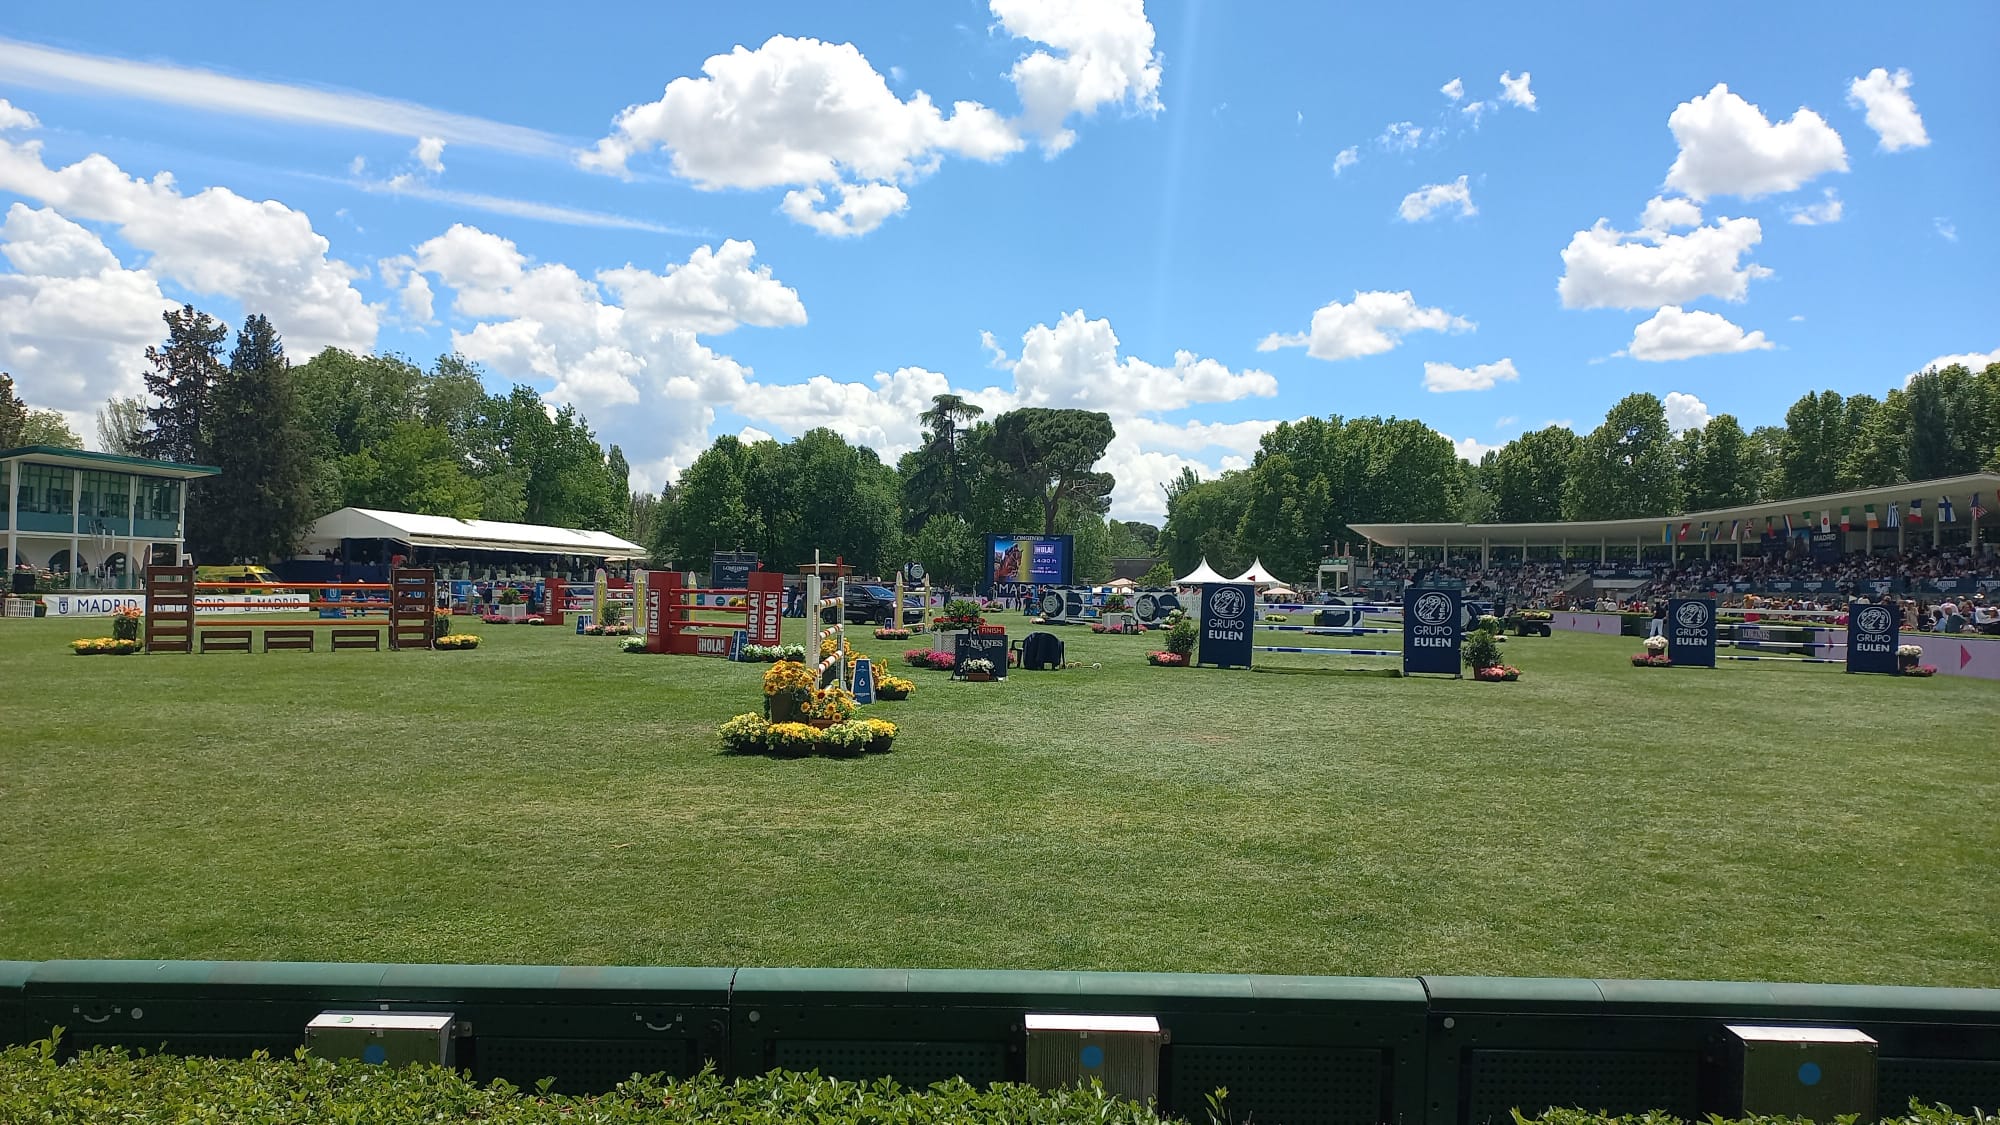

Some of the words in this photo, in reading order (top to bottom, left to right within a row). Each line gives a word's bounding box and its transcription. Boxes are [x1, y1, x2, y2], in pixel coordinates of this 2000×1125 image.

[649, 591, 659, 633] ¡HOLA!
[748, 593, 759, 638] ¡HOLA!
[764, 594, 778, 639] ¡HOLA!
[1208, 618, 1245, 630] GRUPO
[1208, 630, 1244, 641] EULEN
[1413, 625, 1453, 636] GRUPO
[1675, 628, 1709, 637] GRUPO
[1414, 637, 1452, 648] EULEN
[1676, 638, 1708, 646] EULEN
[1856, 633, 1891, 643] GRUPO
[698, 637, 725, 653] ¡HOLA!
[1856, 643, 1890, 652] EULEN
[859, 678, 866, 687] 6
